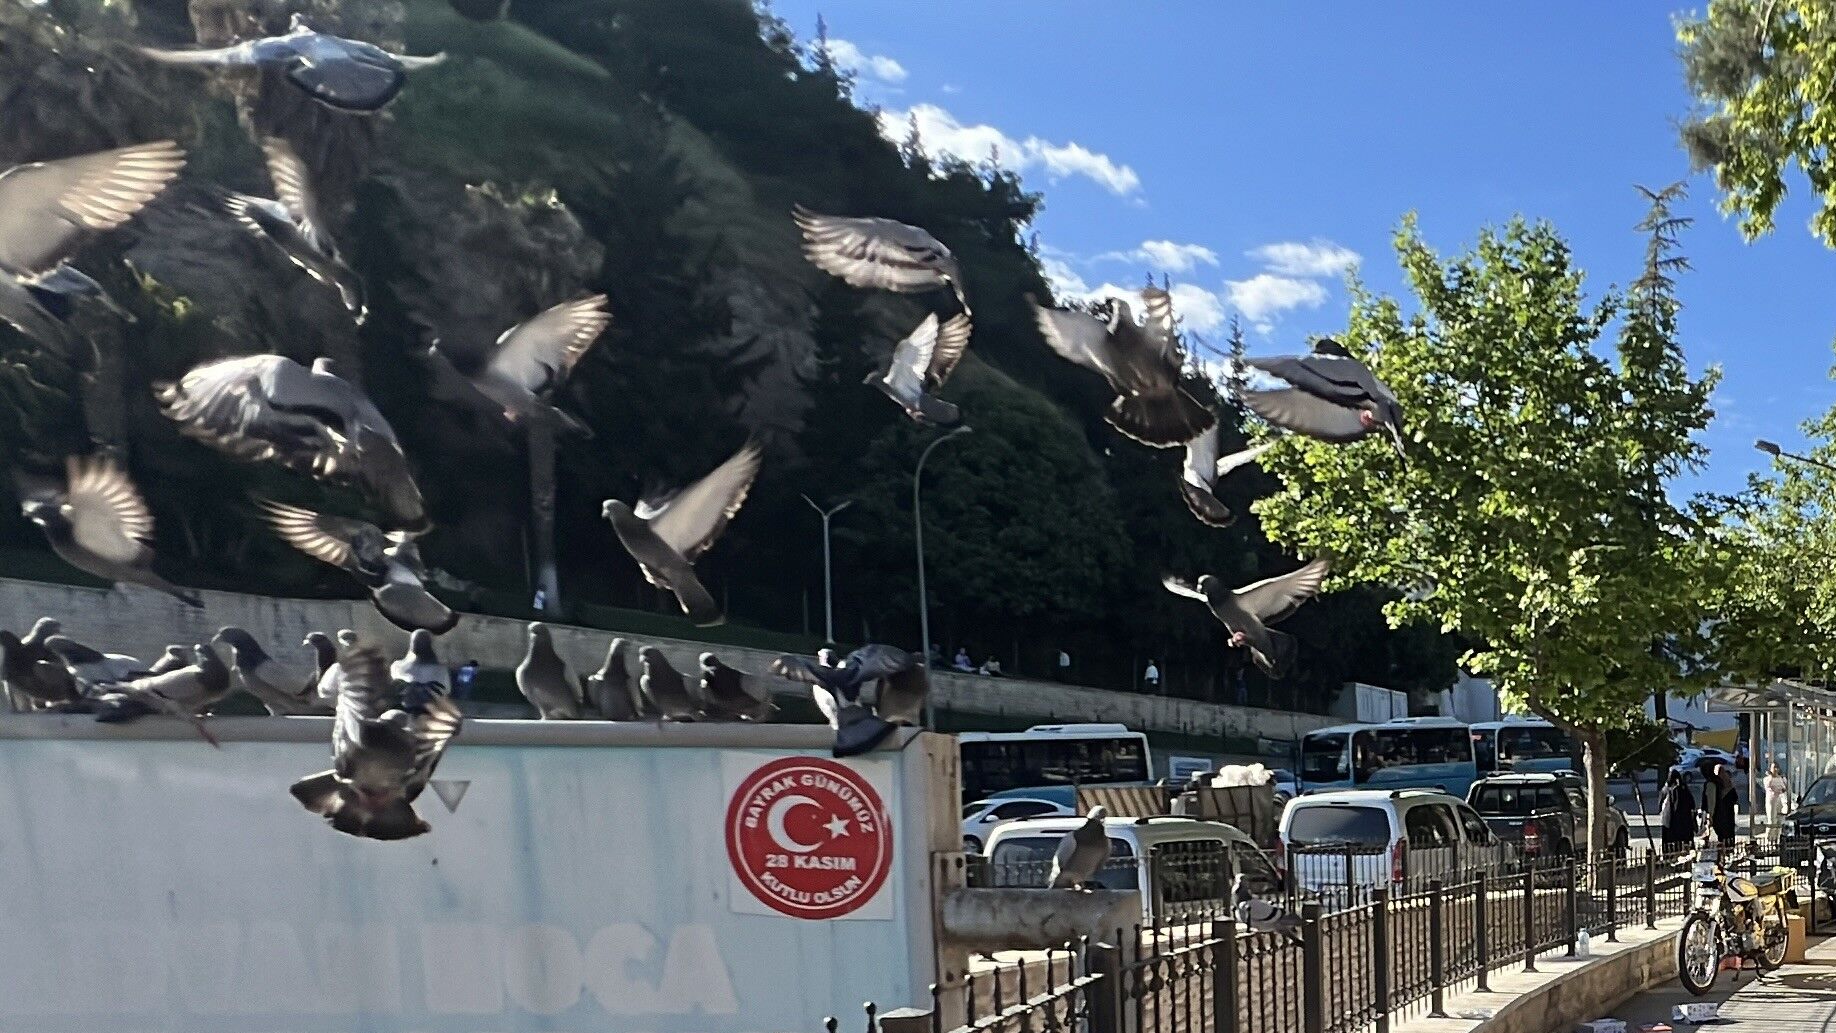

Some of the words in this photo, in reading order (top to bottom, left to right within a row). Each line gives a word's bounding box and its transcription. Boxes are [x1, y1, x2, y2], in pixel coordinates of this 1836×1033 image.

[745, 776, 797, 828] BAYRAK
[765, 854, 789, 868] 28
[794, 854, 856, 871] KASIM
[760, 871, 811, 903] KUTLU
[813, 874, 862, 903] OLSUN
